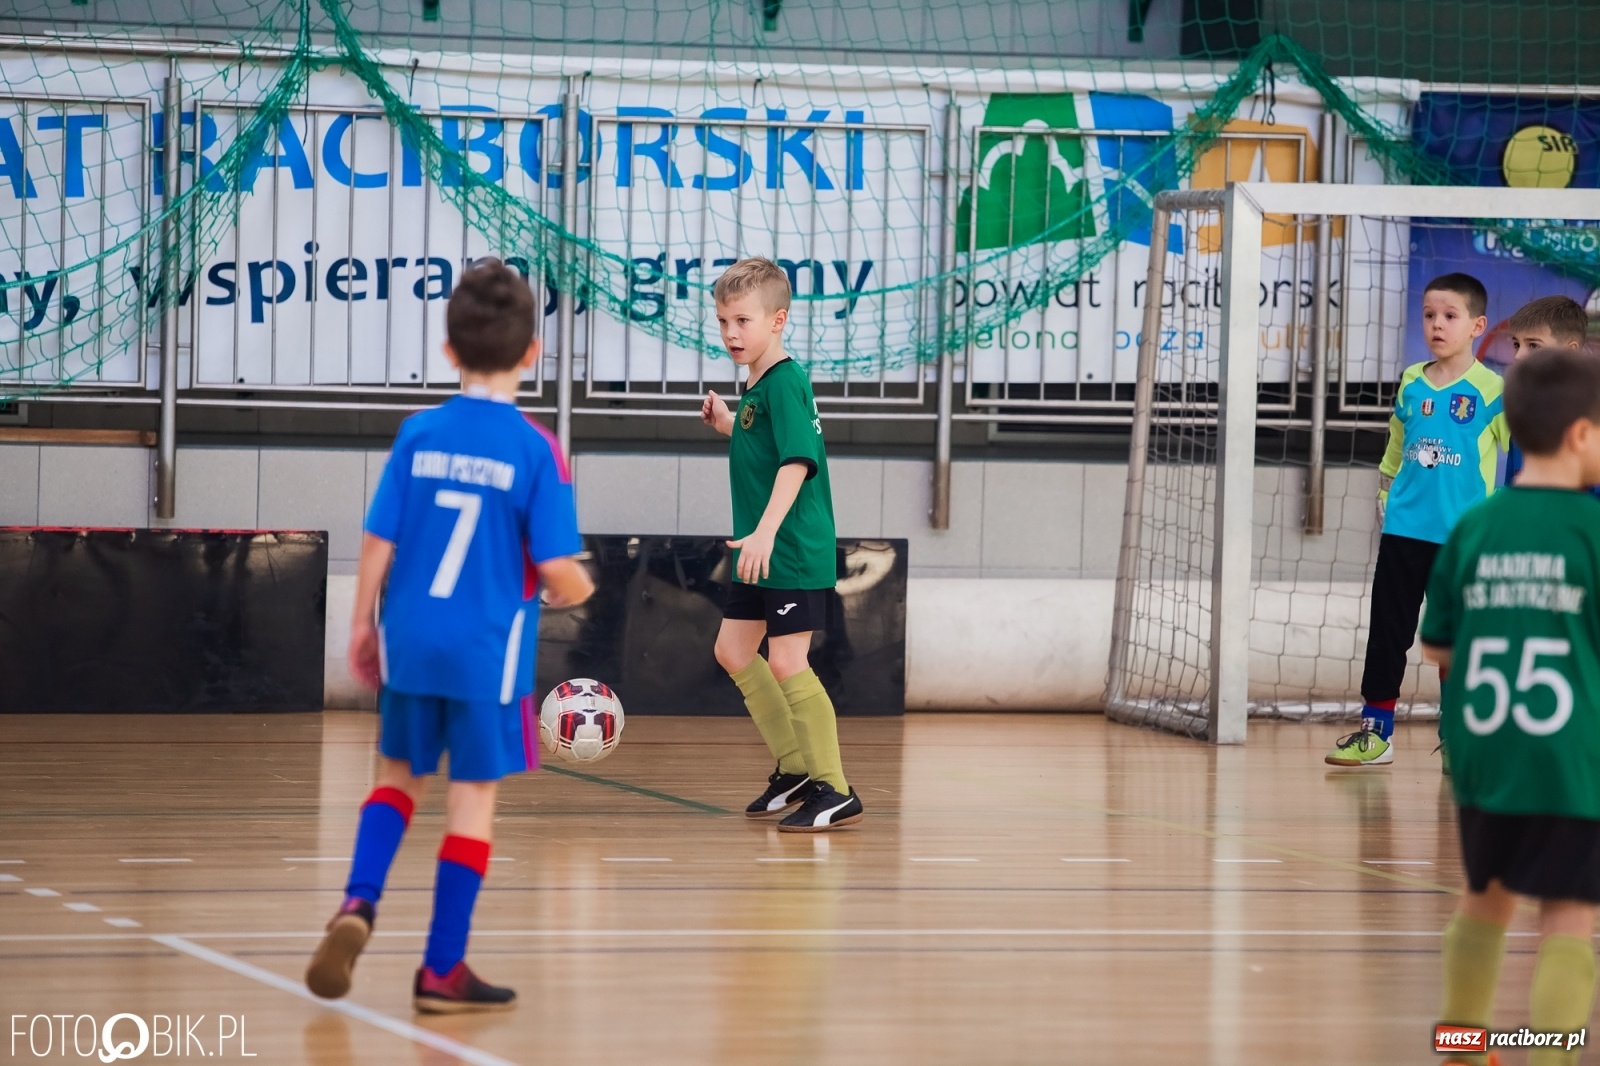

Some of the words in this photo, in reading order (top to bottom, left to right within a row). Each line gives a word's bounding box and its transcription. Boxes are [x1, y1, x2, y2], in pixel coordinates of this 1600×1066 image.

[152, 104, 864, 196] RACIBORSKI
[429, 489, 482, 599] 7
[1462, 636, 1574, 736] 55
